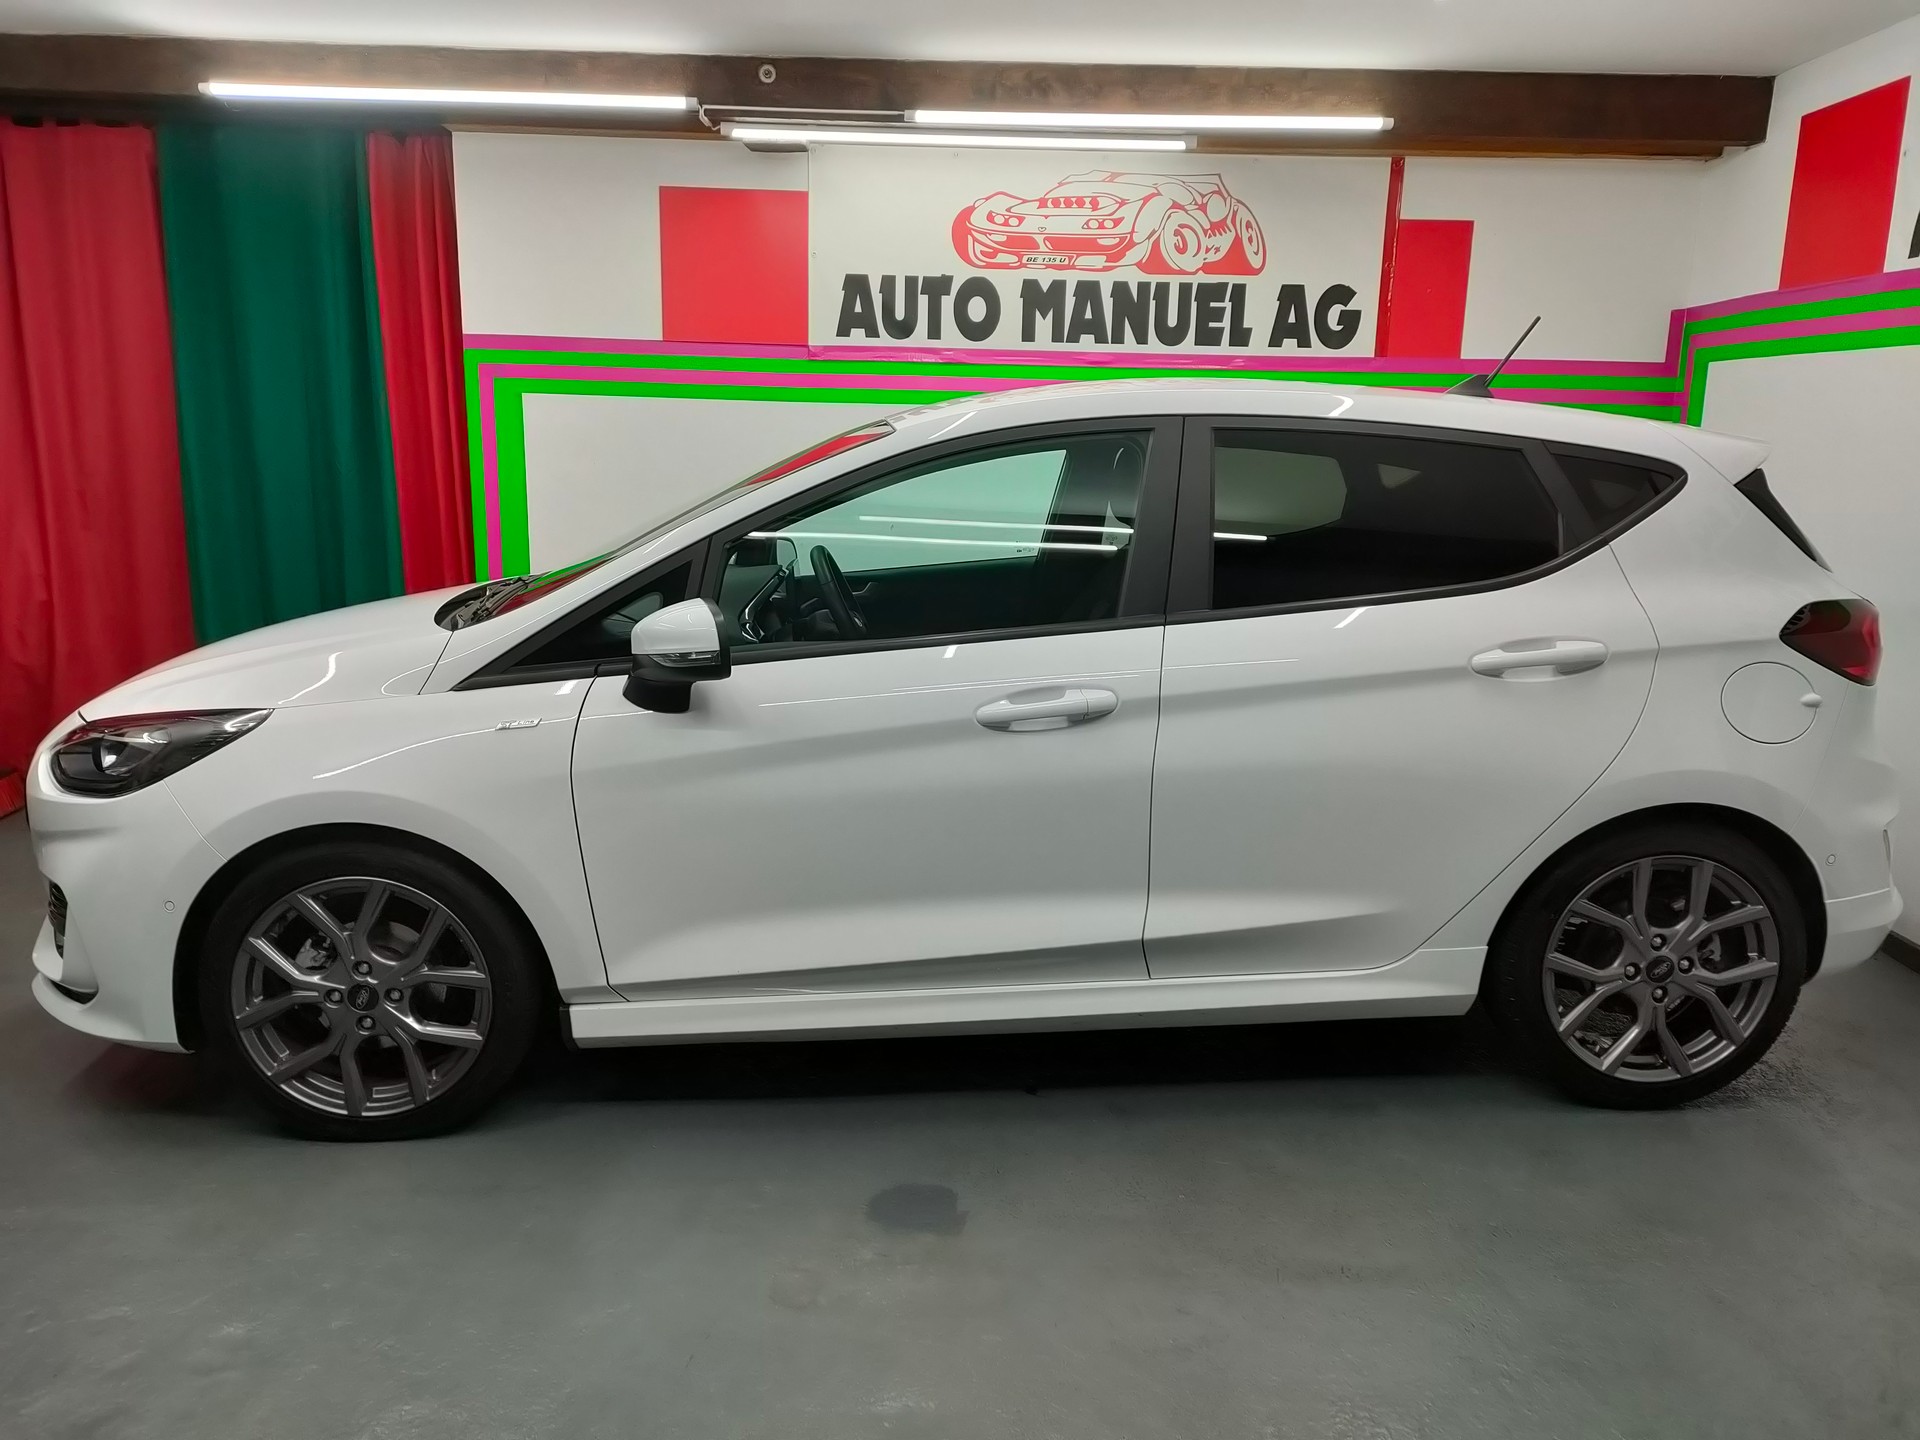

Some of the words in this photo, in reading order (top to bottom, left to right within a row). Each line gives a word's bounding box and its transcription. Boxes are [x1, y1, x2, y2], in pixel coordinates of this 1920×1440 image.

[836, 273, 1001, 343] AUTO
[1020, 278, 1253, 348] MANUEL
[1268, 283, 1362, 350] AG
